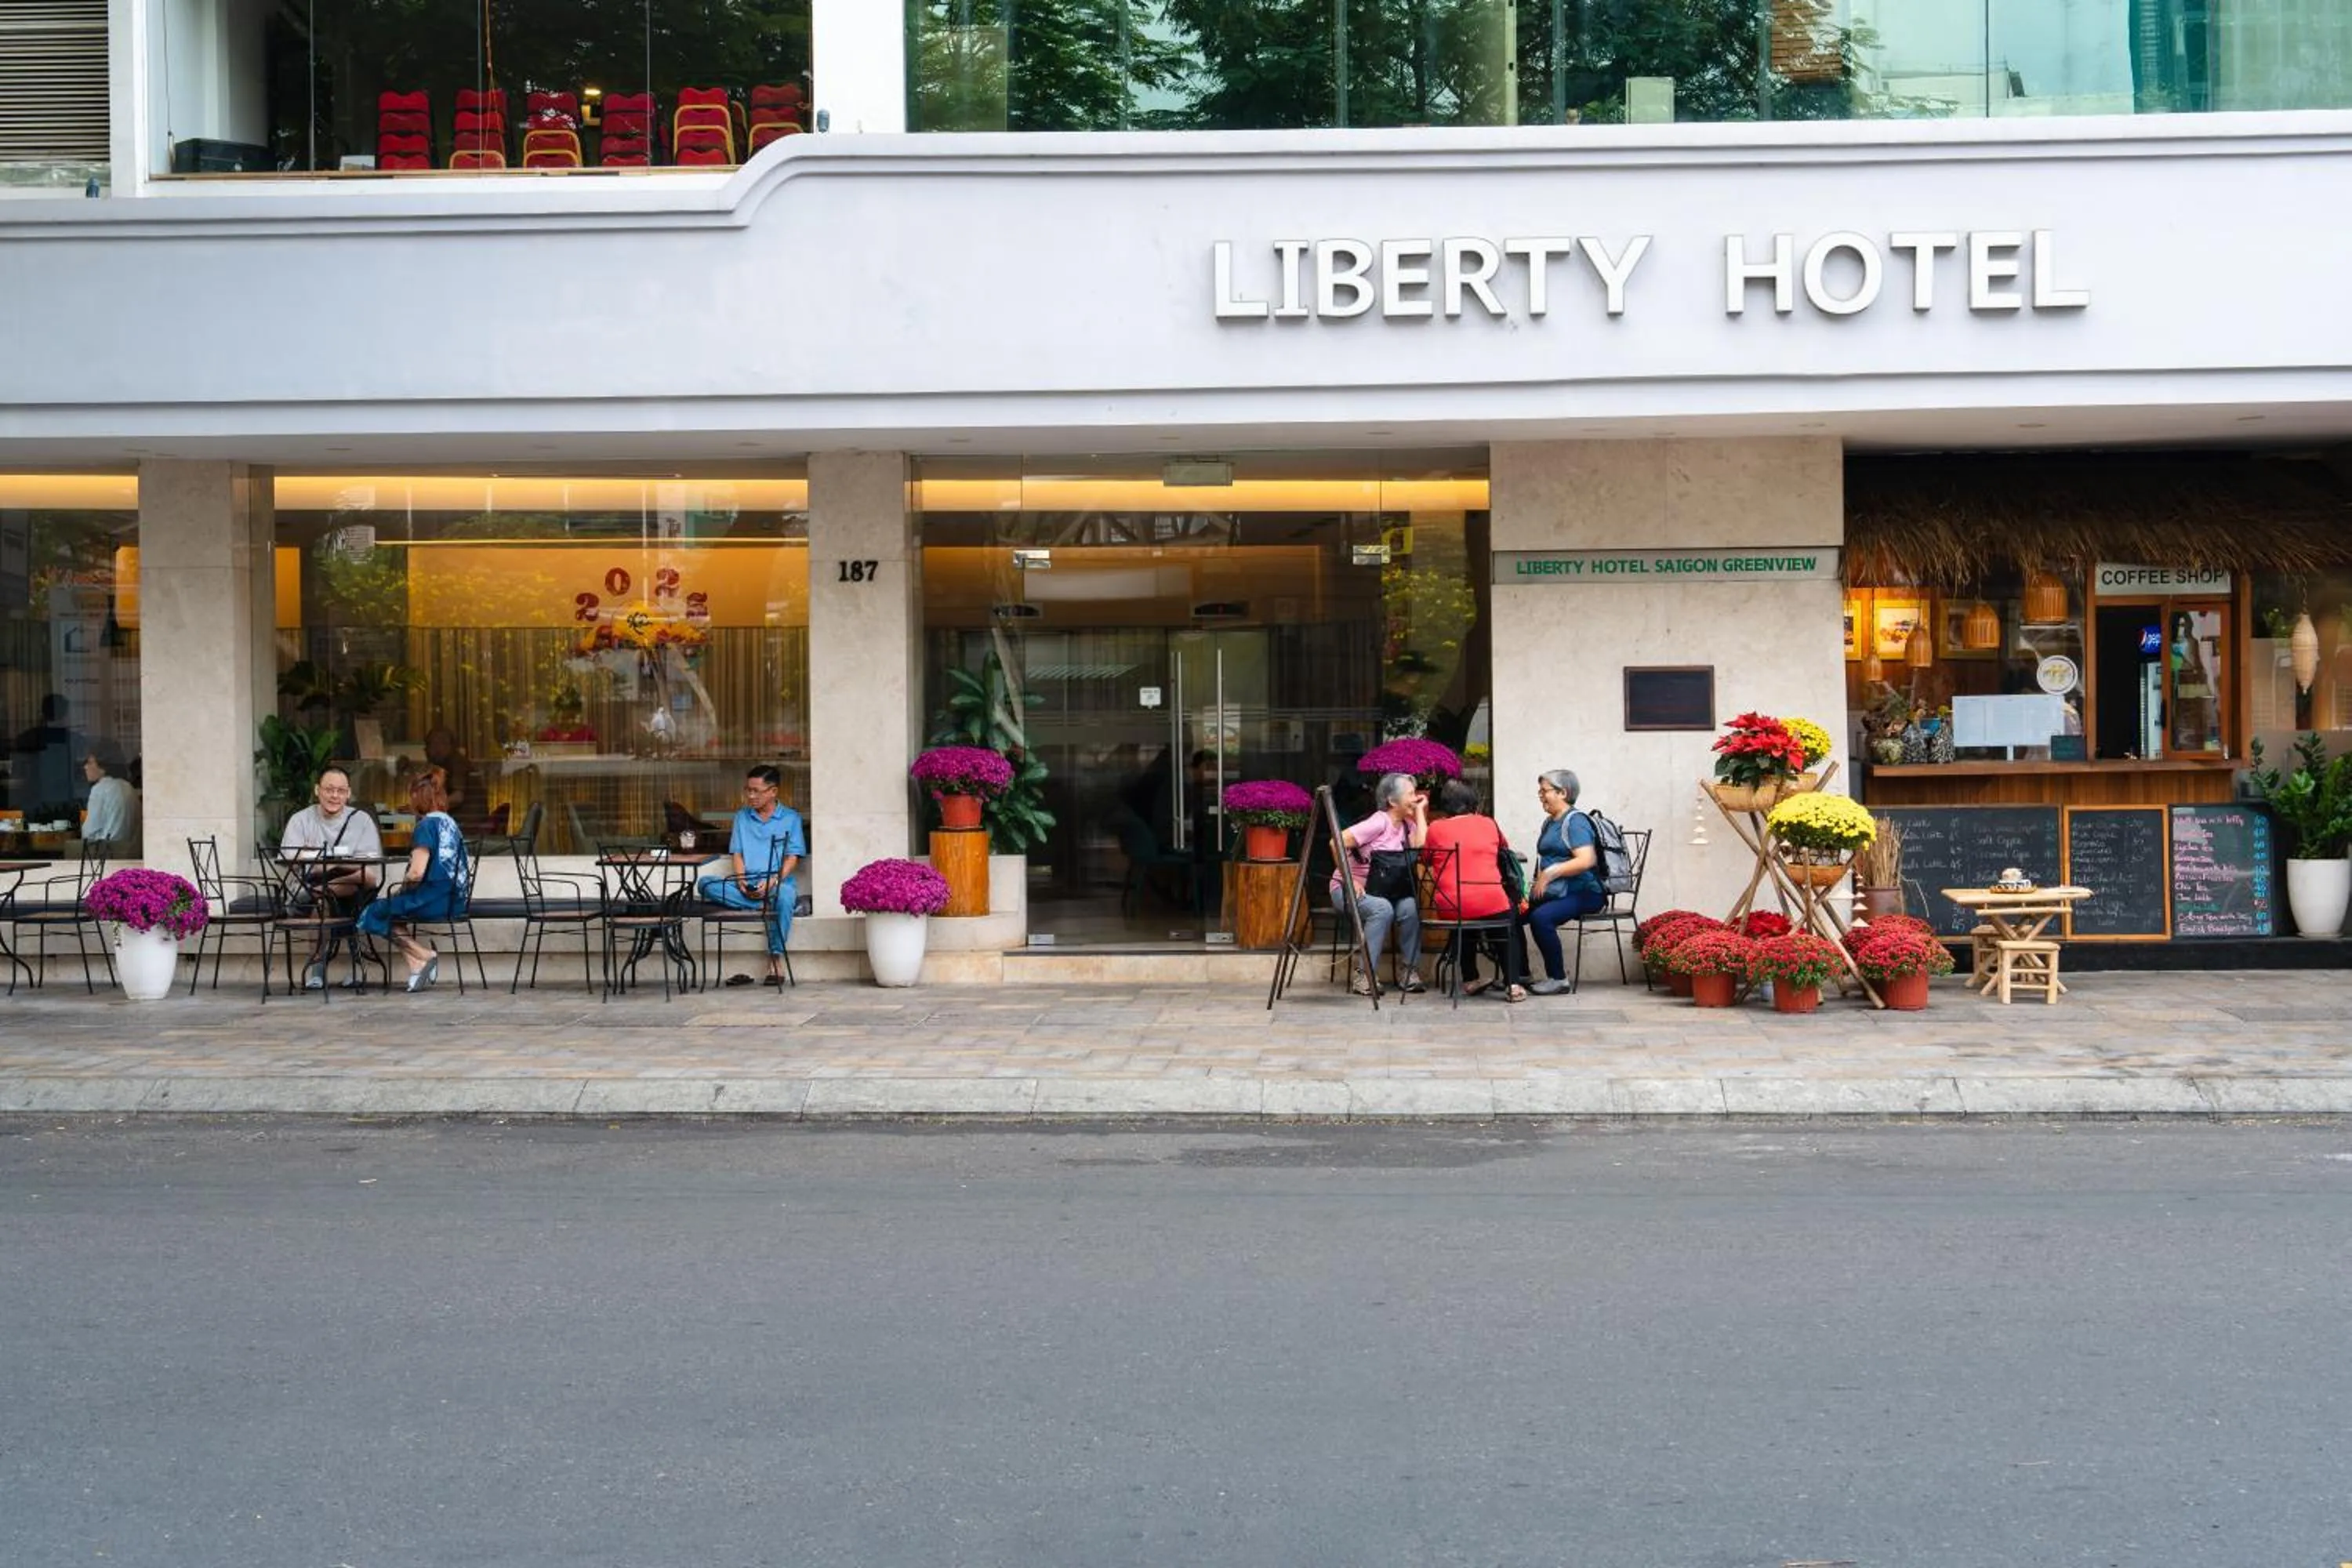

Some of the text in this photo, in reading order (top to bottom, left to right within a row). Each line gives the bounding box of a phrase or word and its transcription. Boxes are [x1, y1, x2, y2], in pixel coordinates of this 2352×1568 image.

[1214, 230, 2091, 318] LIBERTY HOTEL
[838, 560, 878, 583] 187
[1516, 557, 1817, 575] LIBERTY HOTEL SAIGON GREENVIEW
[2102, 568, 2224, 585] COFFEE SHOP
